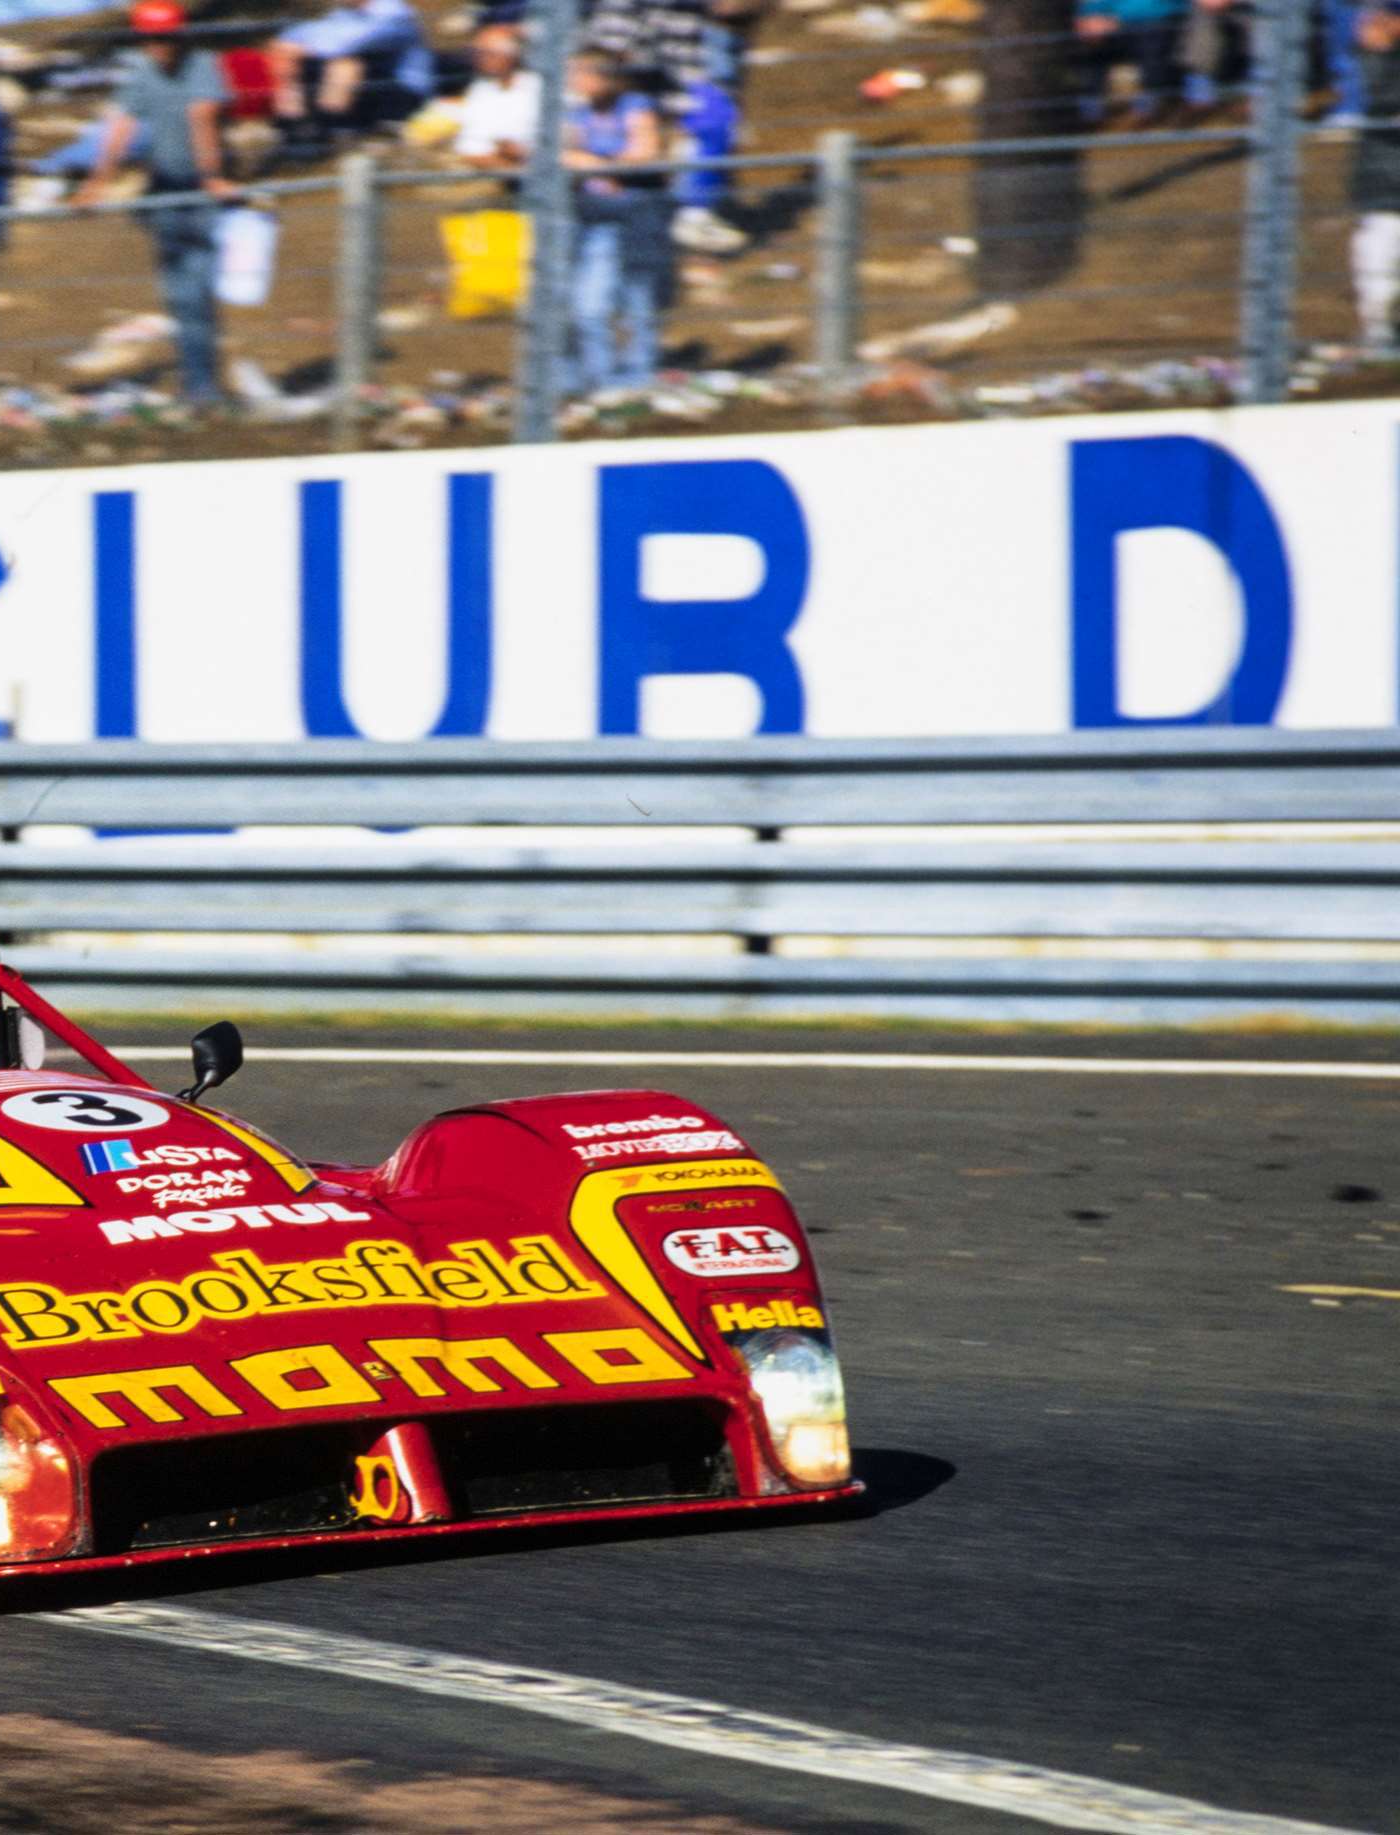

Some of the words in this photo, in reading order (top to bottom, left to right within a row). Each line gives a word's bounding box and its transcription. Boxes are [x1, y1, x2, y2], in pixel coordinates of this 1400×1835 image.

[1068, 425, 1398, 729] D
[32, 1092, 143, 1127] 3
[562, 1115, 704, 1139] brembo
[116, 1169, 252, 1193] DORAN
[651, 1166, 764, 1181] YOKOHAMA
[98, 1202, 372, 1245] MOTUL
[711, 1300, 825, 1333] Hella
[47, 1327, 697, 1430] momo
